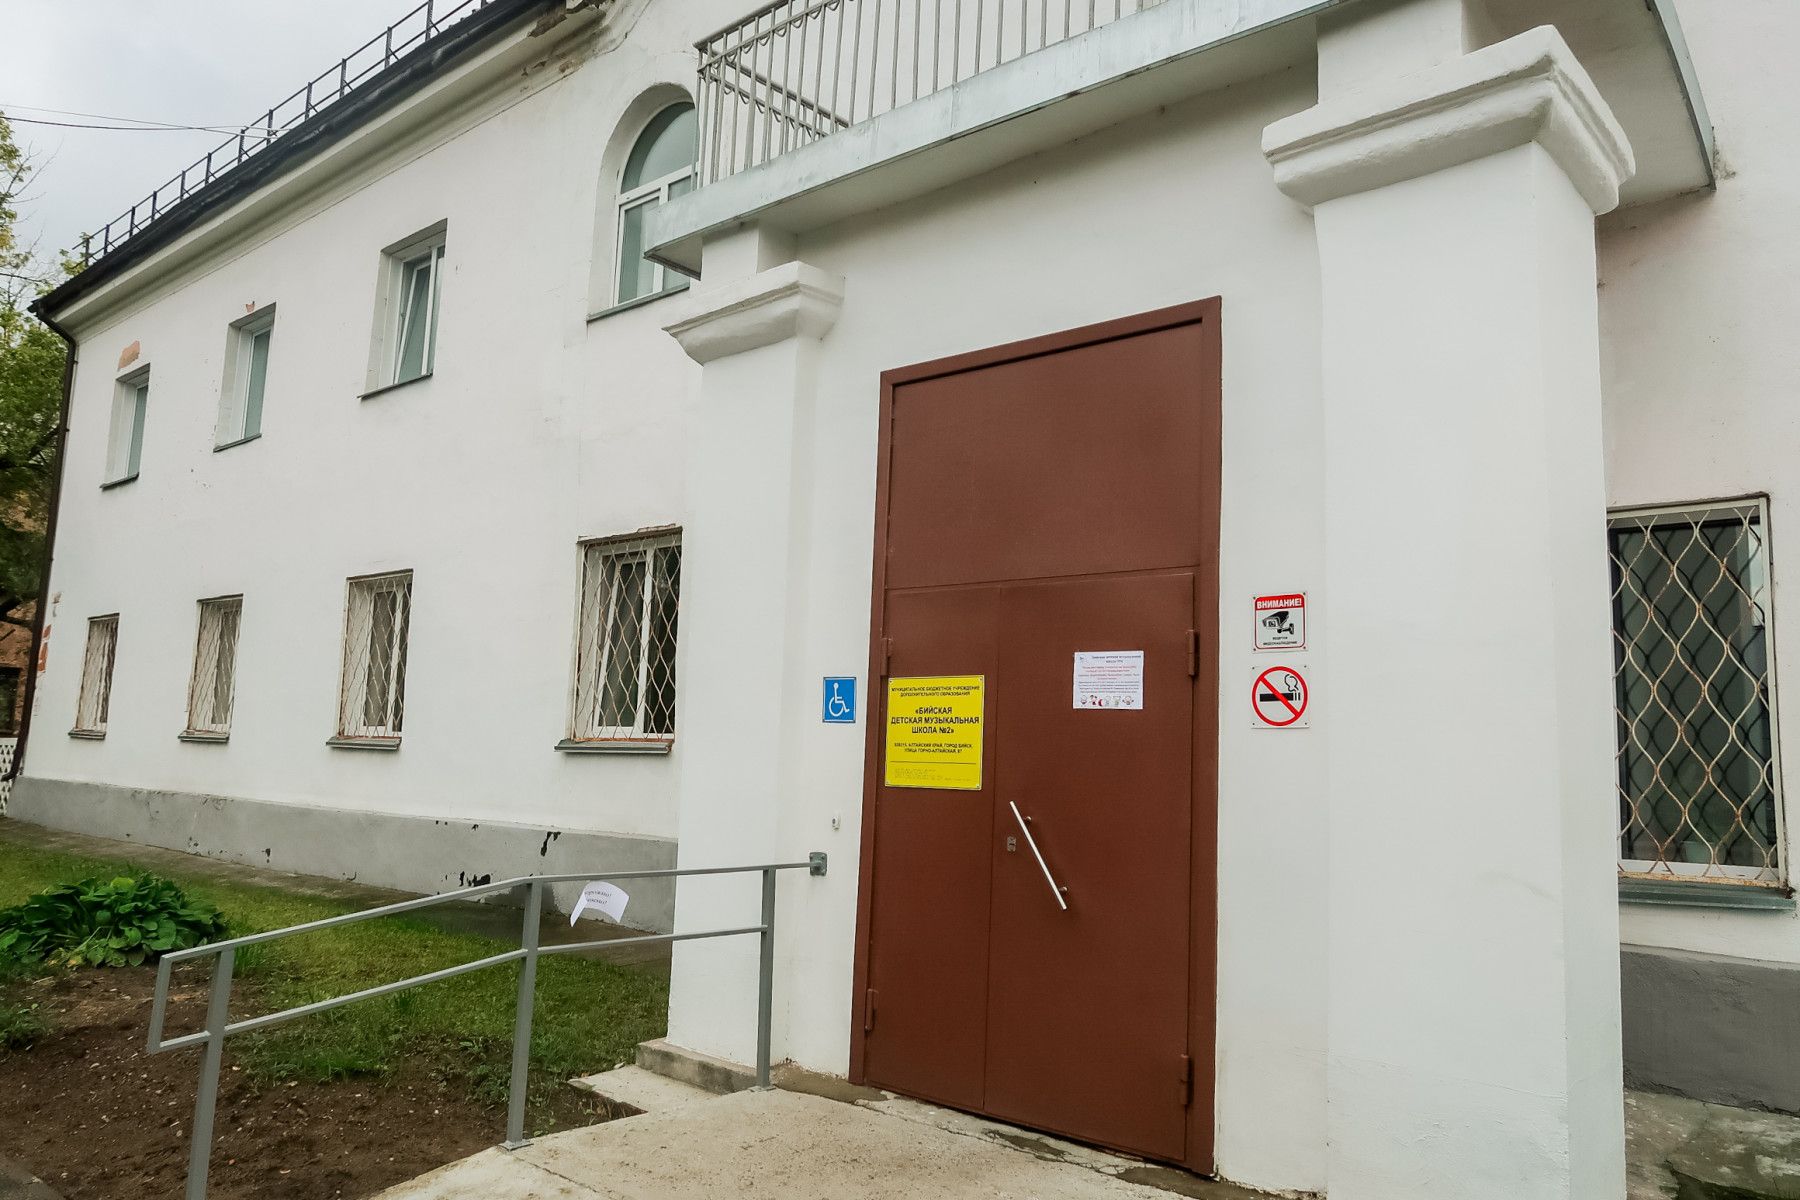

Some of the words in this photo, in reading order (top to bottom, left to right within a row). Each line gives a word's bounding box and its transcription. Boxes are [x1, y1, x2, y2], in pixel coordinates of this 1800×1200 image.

[1256, 598, 1302, 609] ВНИМАНИЕ!
[915, 706, 952, 714] «БИЙСКАЯ
[891, 717, 922, 725] ДЕТСКАЯ
